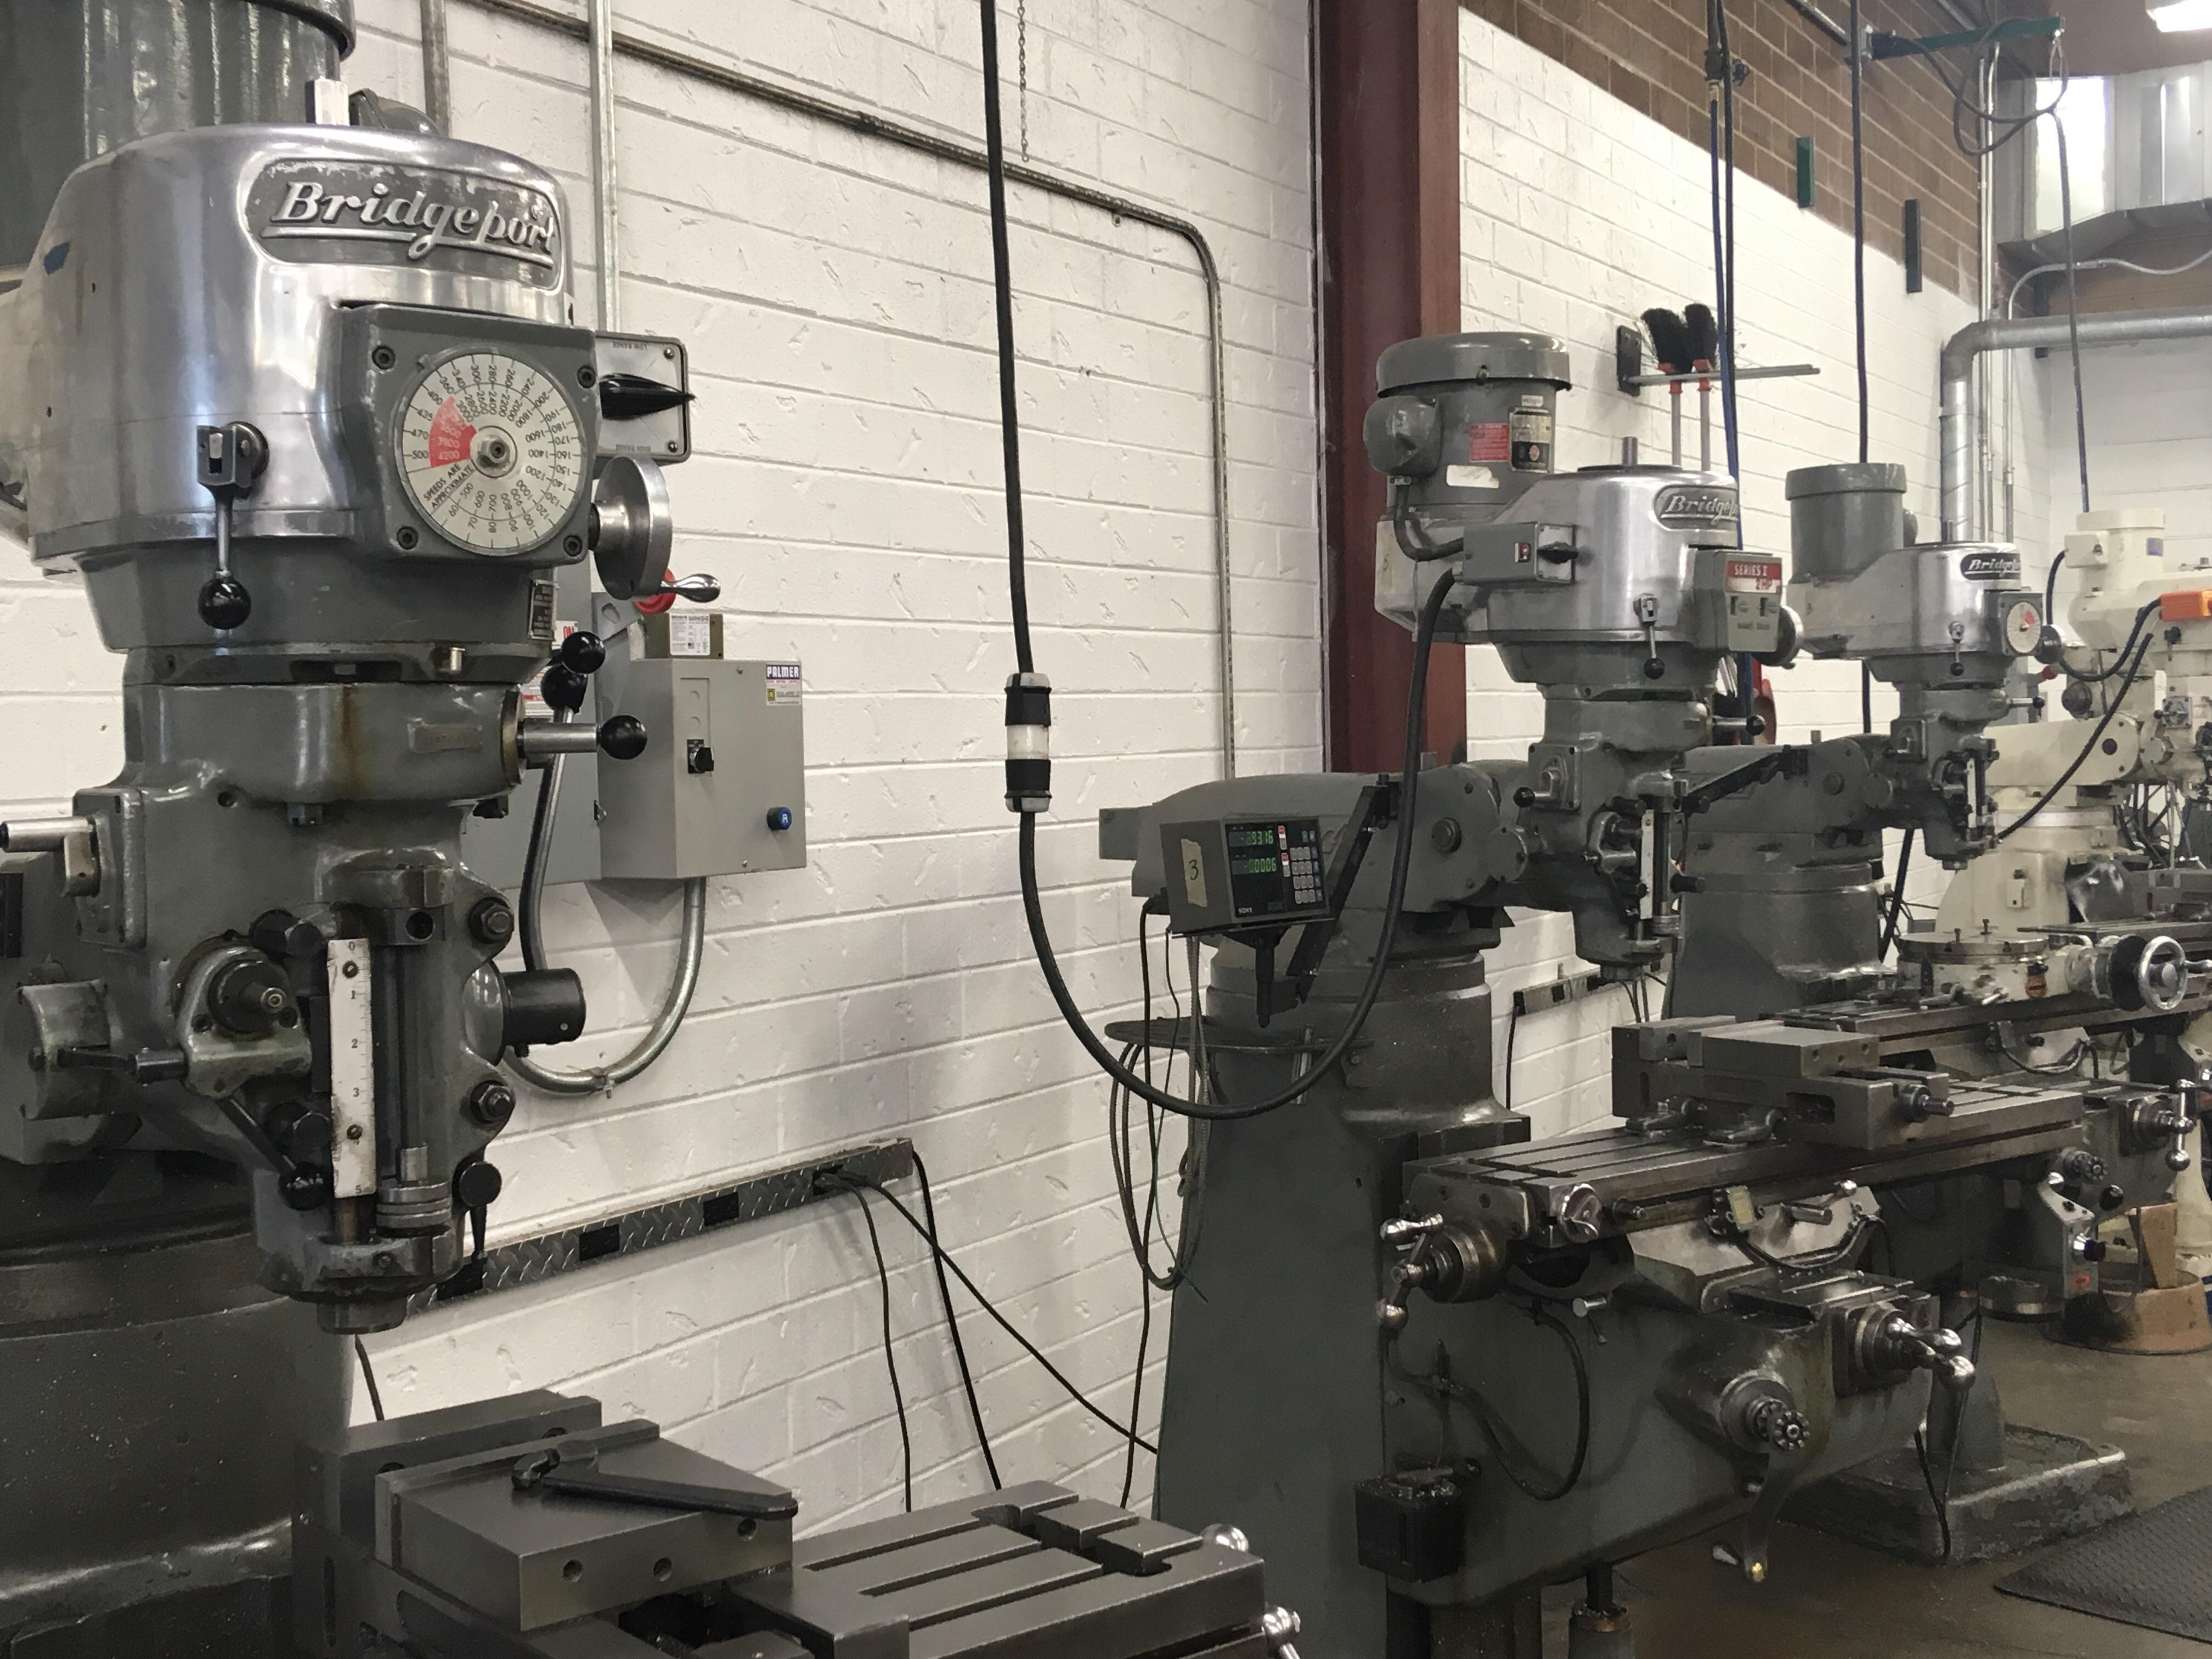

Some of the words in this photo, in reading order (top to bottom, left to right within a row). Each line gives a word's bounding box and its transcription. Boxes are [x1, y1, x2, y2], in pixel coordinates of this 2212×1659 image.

[268, 180, 555, 260] Bridgeport
[453, 369, 465, 388] 340
[471, 364, 482, 383] 300
[489, 365, 497, 383] 280
[505, 369, 516, 387] 260
[522, 378, 534, 395] 240
[428, 391, 443, 405] 400
[477, 391, 489, 415] 2600
[489, 391, 497, 415] 2400
[499, 393, 510, 417] 2200
[535, 391, 550, 408] 200
[456, 400, 474, 422] 3000
[464, 394, 481, 417] 2800
[507, 399, 522, 422] 2000
[417, 409, 433, 421] 435
[515, 409, 533, 428] 1800
[545, 408, 560, 421] 190
[551, 421, 567, 433] 180
[411, 430, 428, 439] 470
[526, 430, 545, 443] 1600
[555, 435, 571, 445] 170
[413, 450, 428, 459] 500
[528, 449, 548, 458] 1400
[557, 450, 571, 459] 160
[526, 465, 546, 481] 1200
[556, 465, 570, 476] 150
[423, 477, 447, 501] SPEEDS
[447, 463, 461, 478] ARE
[431, 465, 475, 509] APPROXIMATE
[552, 478, 567, 491] 140
[460, 483, 473, 499] 500
[516, 479, 533, 500] 1000
[489, 494, 497, 512] 700
[511, 488, 523, 506] 900
[545, 493, 560, 506] 130
[448, 505, 459, 517] 60
[536, 504, 550, 520] 120
[468, 517, 478, 529] 70
[488, 522, 496, 533] 80
[509, 520, 518, 532] 90
[523, 514, 535, 530] 100
[1735, 564, 1761, 576] SERIES
[767, 666, 799, 678] PALMER
[782, 814, 789, 823] R
[1188, 859, 1199, 881] 3
[348, 941, 356, 951] 0
[351, 990, 356, 999] 1
[351, 1038, 358, 1048] 2
[353, 1087, 359, 1097] 3
[356, 1184, 362, 1194] 5
